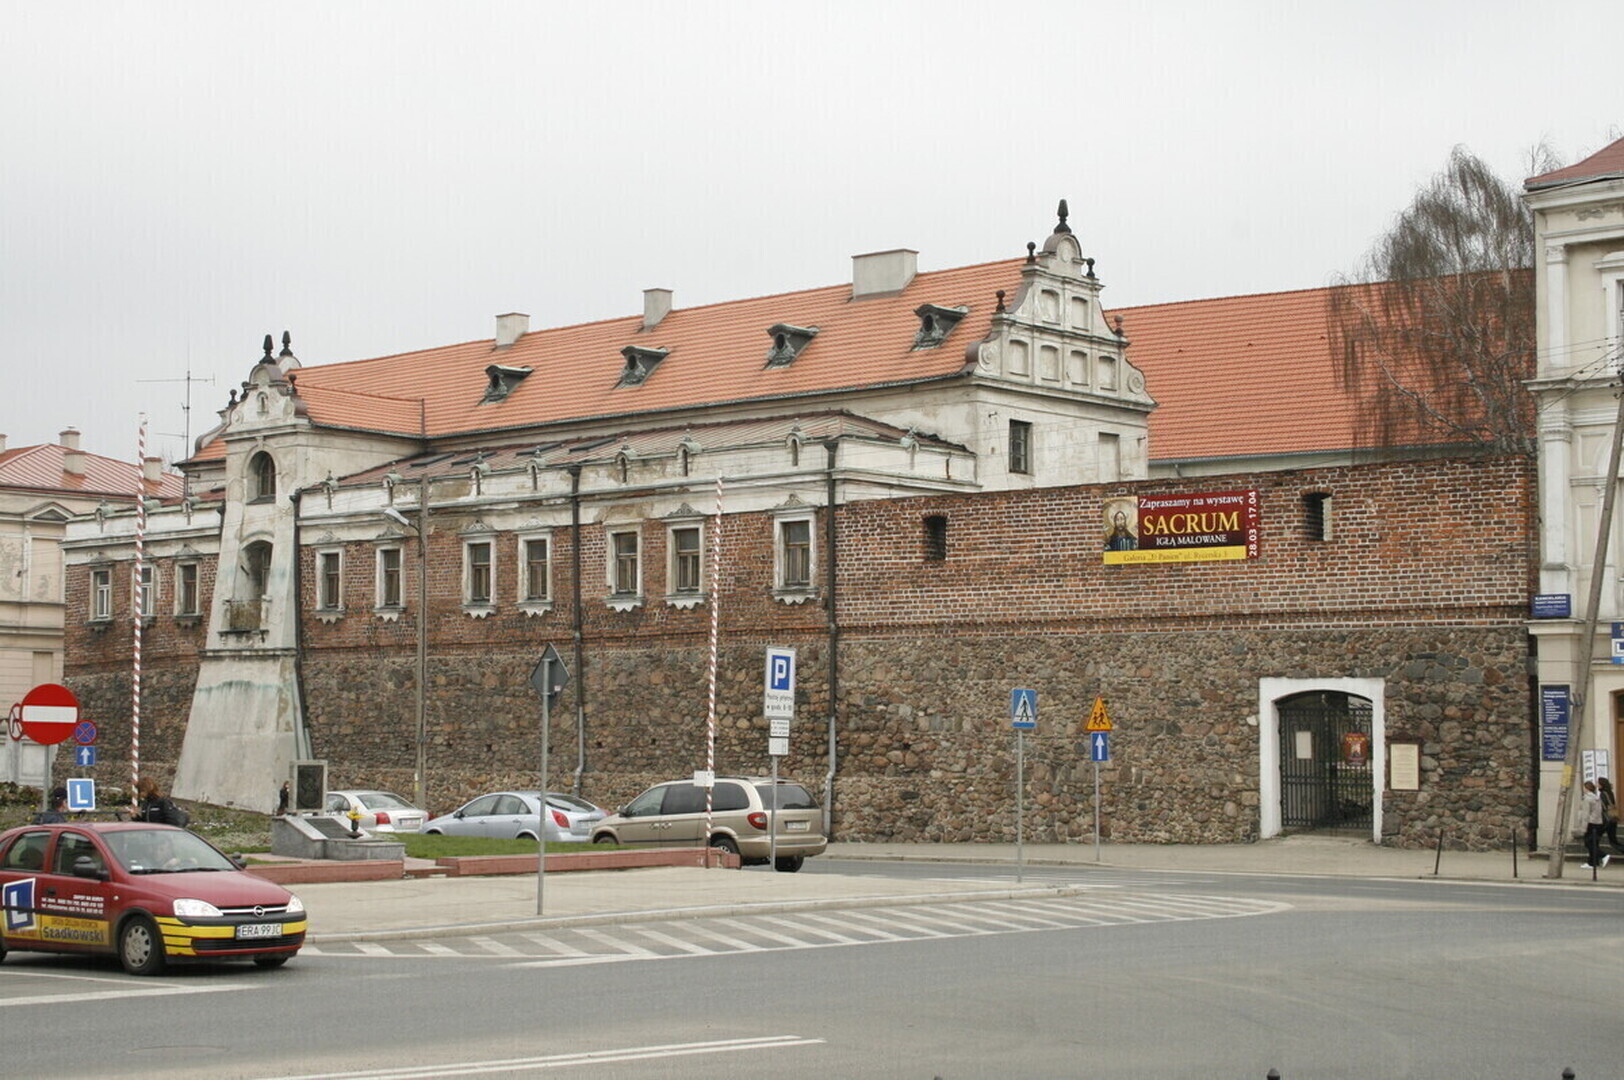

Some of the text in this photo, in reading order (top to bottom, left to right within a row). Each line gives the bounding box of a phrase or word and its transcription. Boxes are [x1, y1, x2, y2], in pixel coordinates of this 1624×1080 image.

[1140, 495, 1244, 510] Zapraszamy na wystawę
[1249, 491, 1257, 519] 17.04
[1143, 511, 1241, 536] SACRUM
[1156, 534, 1228, 547] IGŁĄ MALOWANE
[1249, 528, 1257, 556] 28.03
[774, 658, 787, 686] P
[77, 785, 88, 804] L
[10, 891, 28, 924] L
[43, 926, 104, 943] Szadkowski
[242, 925, 260, 936] ERA
